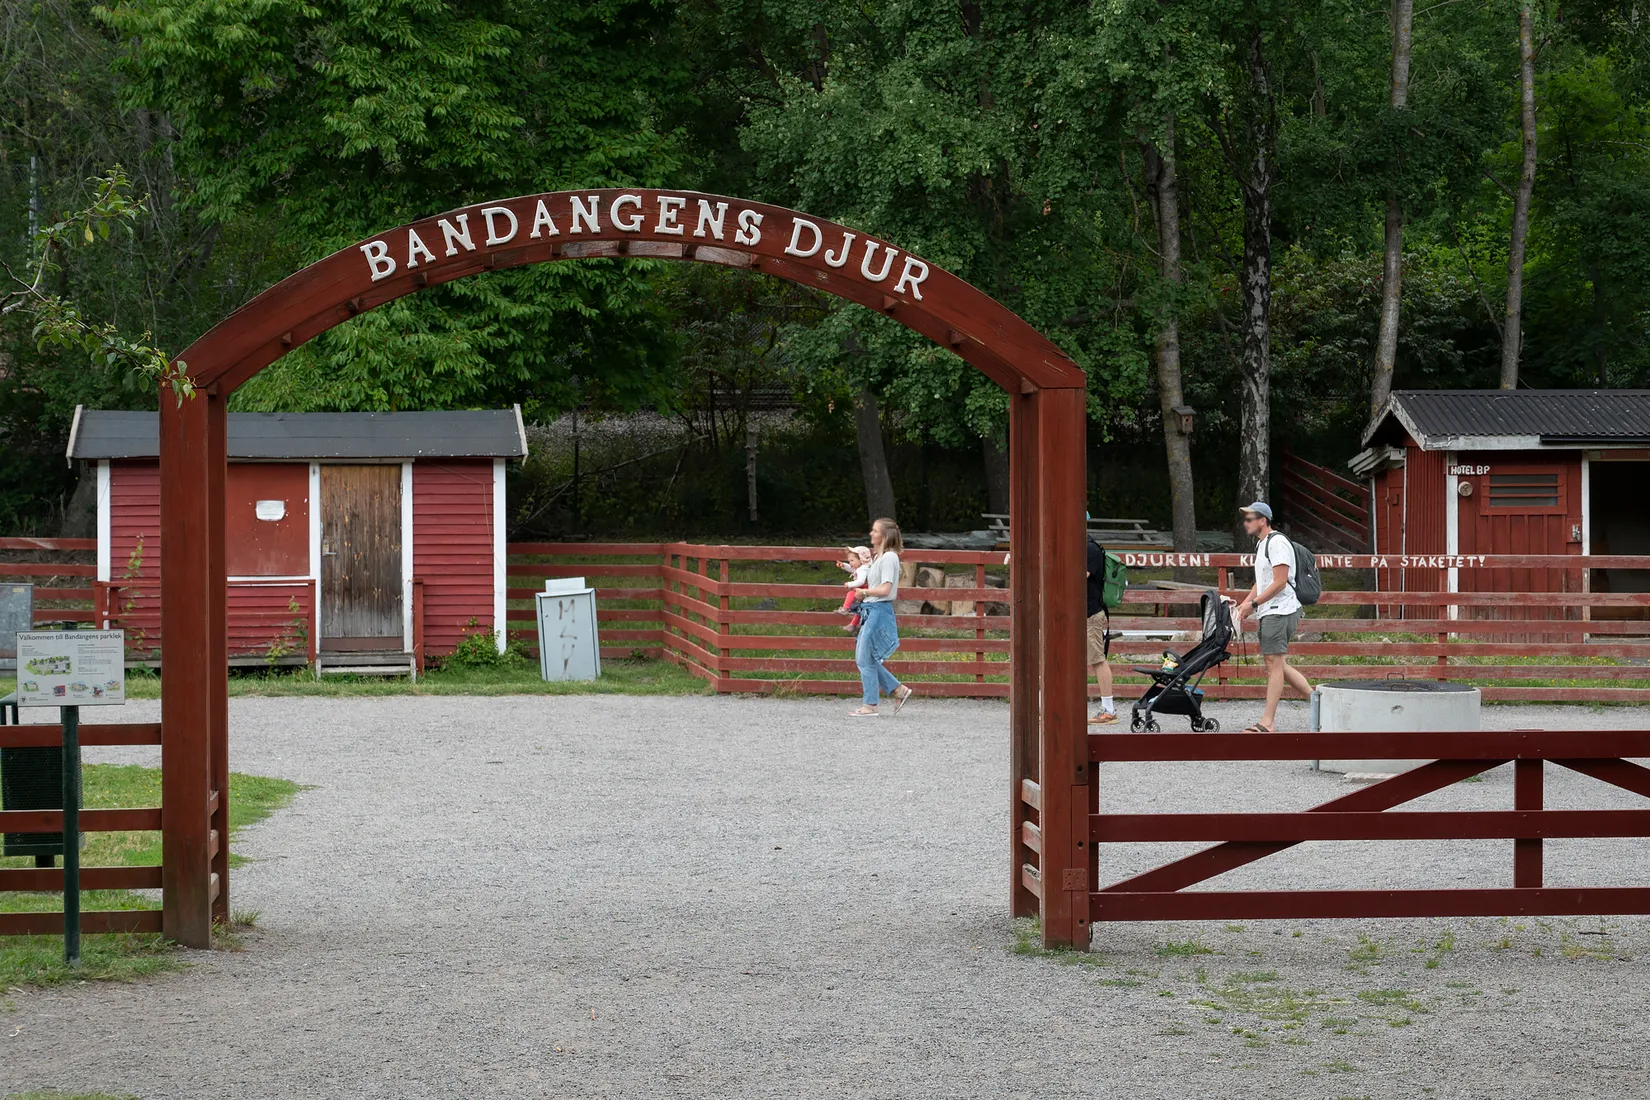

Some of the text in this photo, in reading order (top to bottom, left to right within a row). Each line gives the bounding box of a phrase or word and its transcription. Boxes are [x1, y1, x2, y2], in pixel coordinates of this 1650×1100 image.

[360, 195, 929, 301] BANDANGENS DJUR
[1450, 465, 1490, 475] HOTEL BP
[1125, 553, 1210, 567] DJUREN!
[1320, 555, 1353, 568] INTE
[1400, 556, 1485, 568] STAKETET!
[100, 632, 122, 640] parklek
